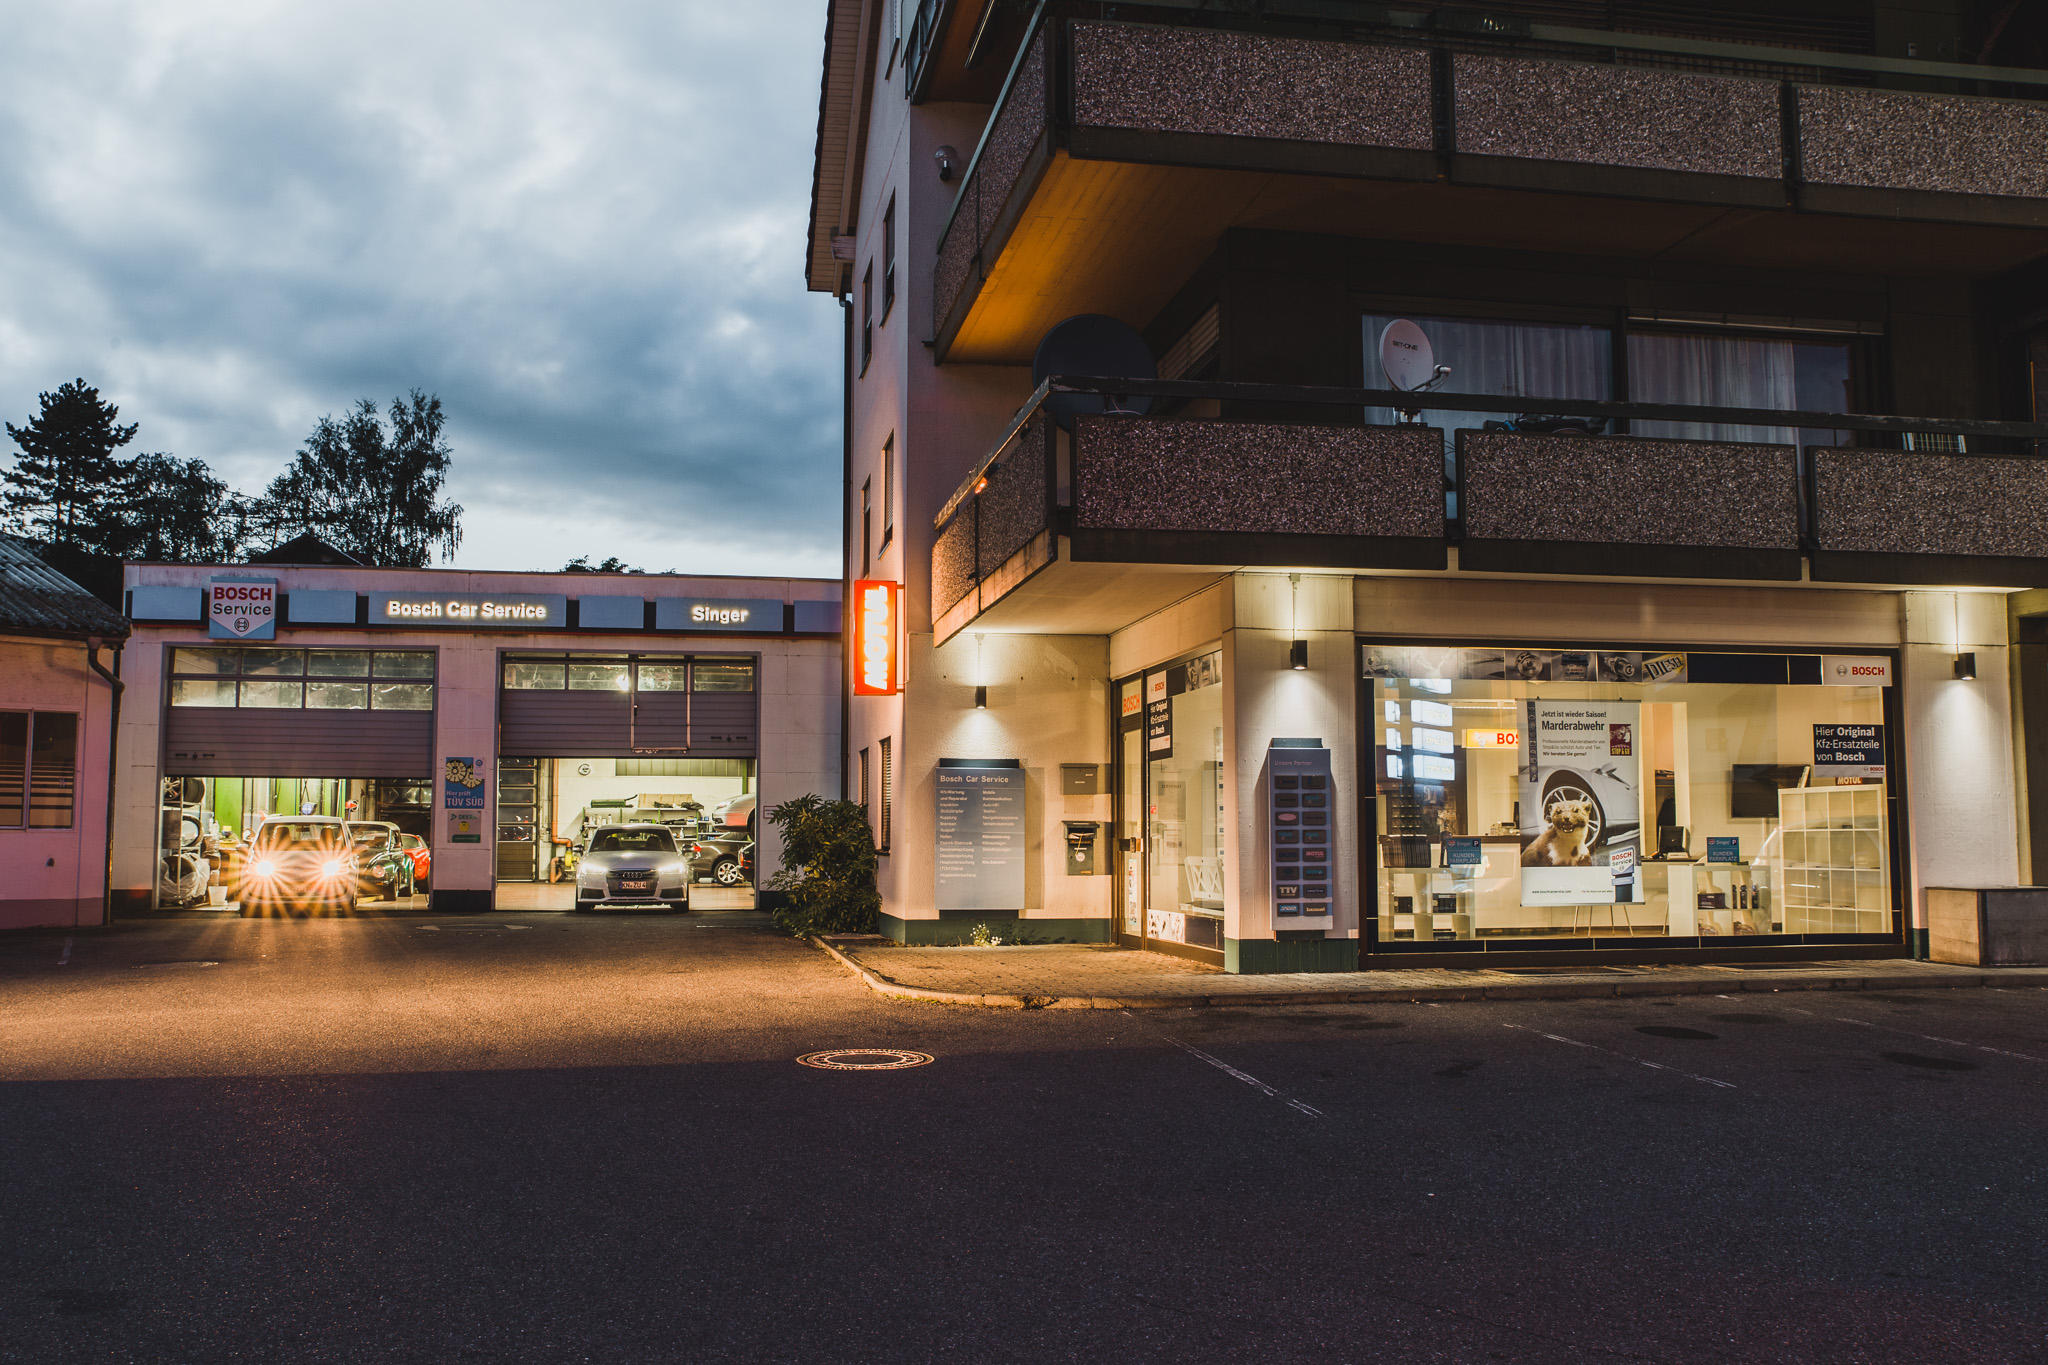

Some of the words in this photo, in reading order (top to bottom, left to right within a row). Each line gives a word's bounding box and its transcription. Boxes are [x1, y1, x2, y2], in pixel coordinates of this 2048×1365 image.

[214, 587, 272, 600] BOSCH
[213, 603, 271, 615] Service
[388, 600, 442, 617] Bosch
[446, 601, 478, 617] Car
[481, 602, 547, 618] Service
[692, 605, 748, 624] Singer
[1852, 666, 1885, 675] BOSCH
[1123, 693, 1141, 713] BOSCH
[1541, 720, 1605, 731] Marderabwehr
[1816, 727, 1834, 736] Hier
[1837, 727, 1875, 738] Original
[1816, 739, 1879, 749] Kfz-Ersatzteile
[1836, 752, 1865, 761] Bosch
[940, 775, 963, 783] Bosch
[965, 775, 978, 783] Car
[1837, 777, 1862, 785] MOTUL
[448, 797, 464, 806] TÜV
[466, 796, 483, 806] SÜD
[1612, 852, 1632, 860] BOSCH
